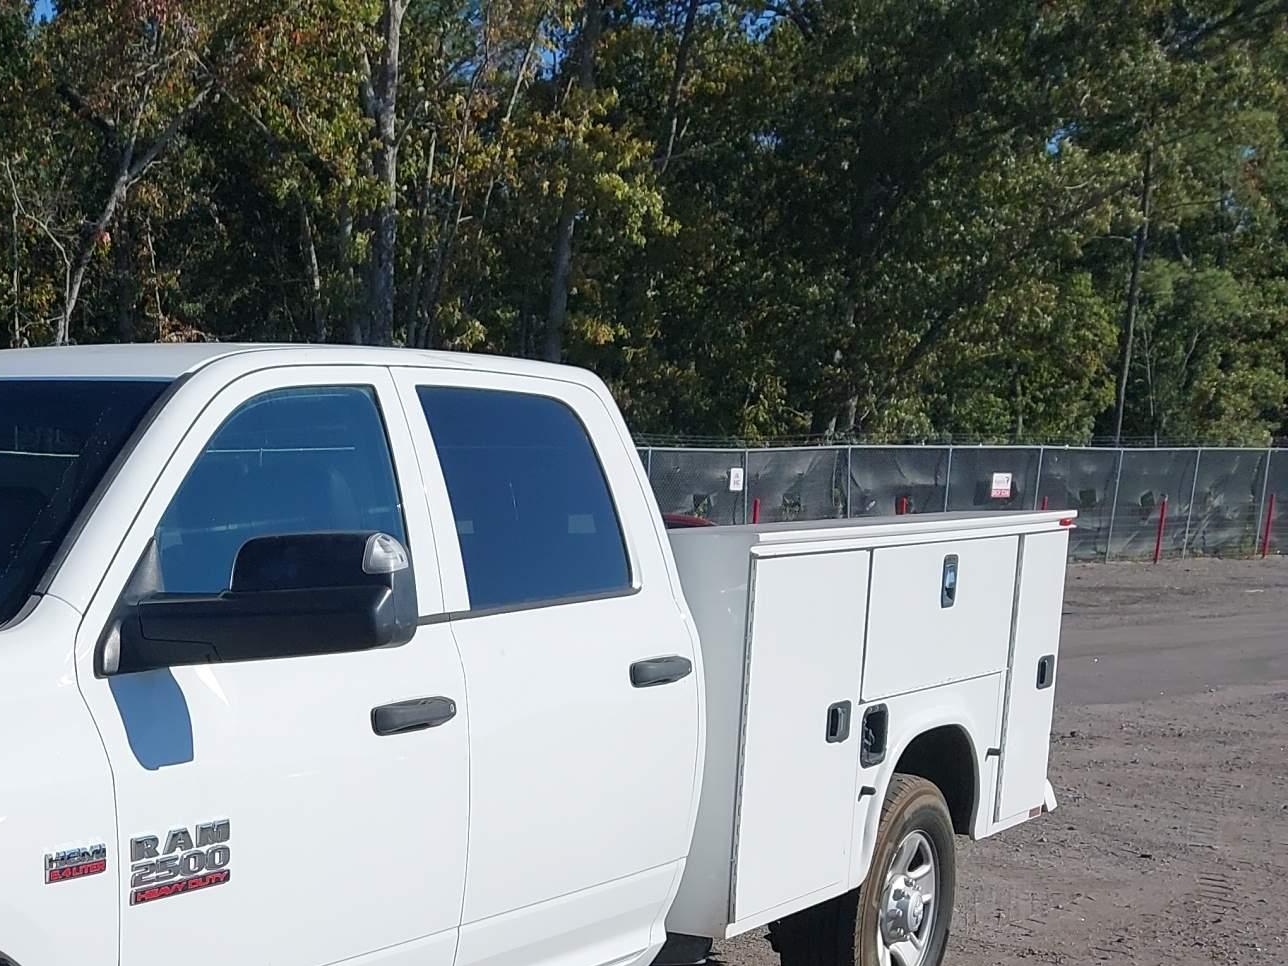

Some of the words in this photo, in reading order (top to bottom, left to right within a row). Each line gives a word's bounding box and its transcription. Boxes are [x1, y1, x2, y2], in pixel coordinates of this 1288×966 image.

[44, 843, 106, 870] HEMI
[130, 819, 230, 862] RAM
[130, 845, 230, 888] 2500
[136, 881, 187, 902] HEAVY
[187, 871, 229, 889] DUTY
